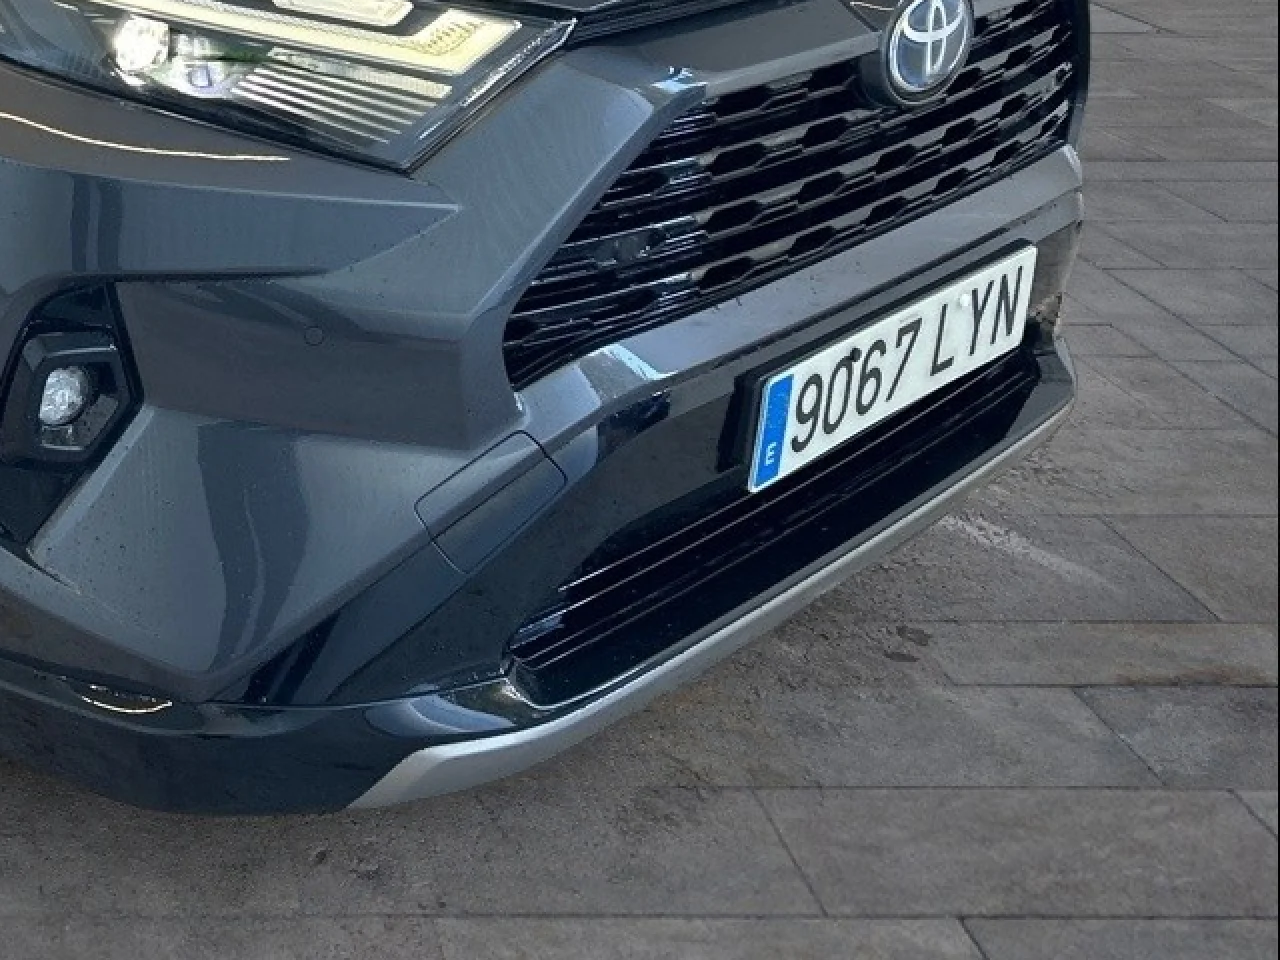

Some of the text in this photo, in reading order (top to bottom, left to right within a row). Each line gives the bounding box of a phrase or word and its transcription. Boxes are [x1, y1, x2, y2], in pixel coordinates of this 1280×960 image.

[791, 265, 1023, 453] 9067 LYN
[765, 443, 777, 466] E
